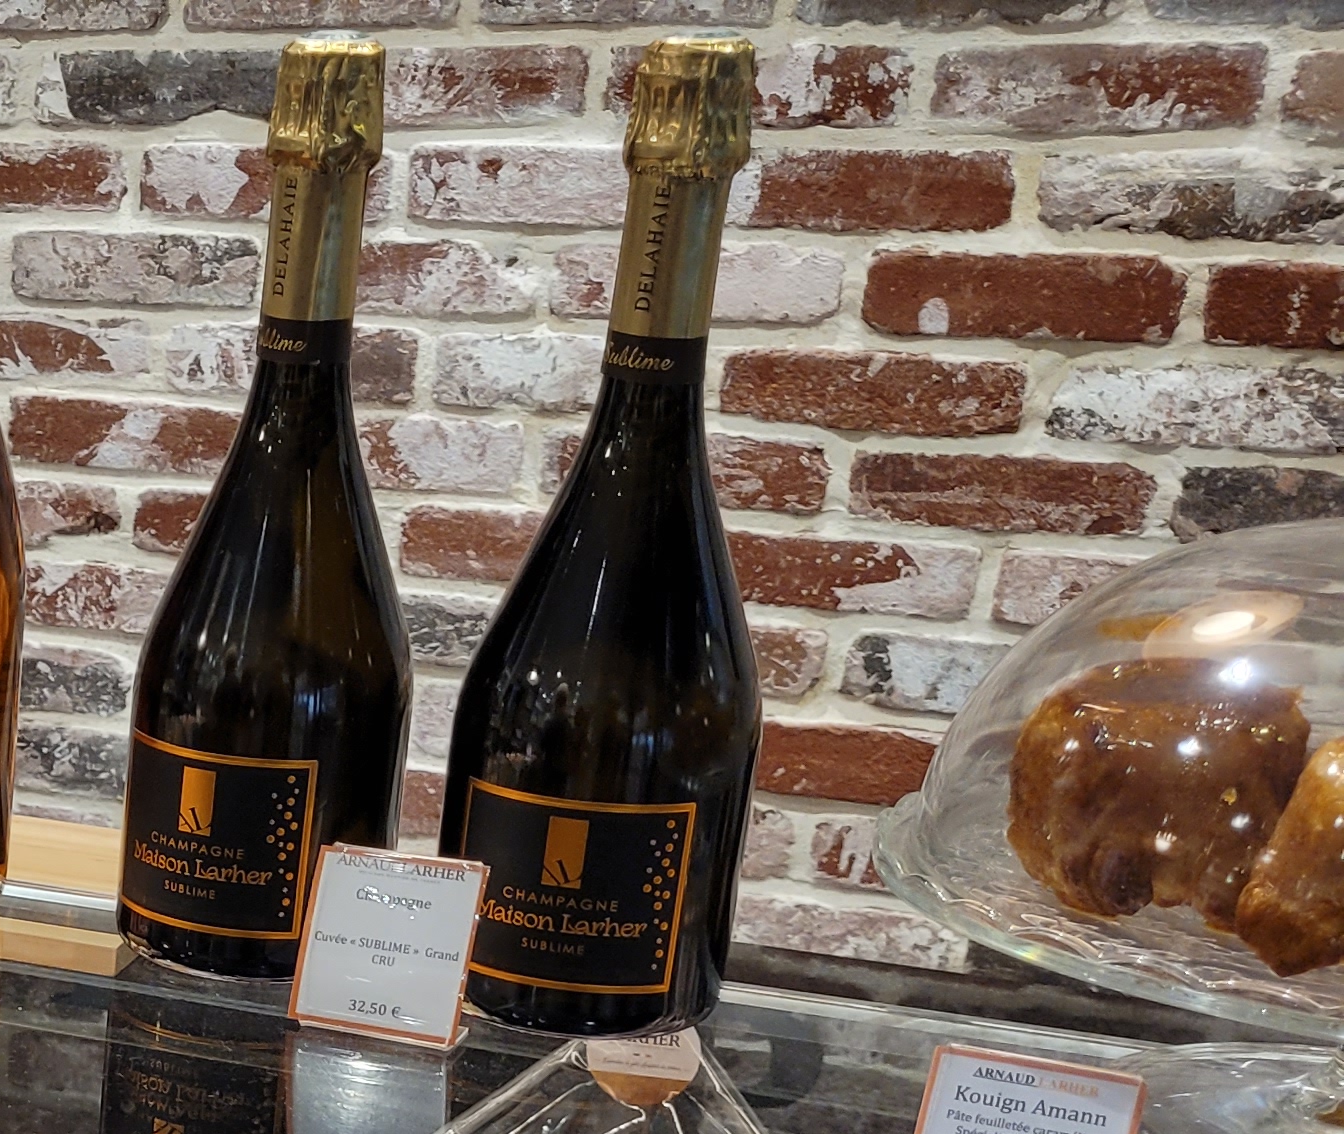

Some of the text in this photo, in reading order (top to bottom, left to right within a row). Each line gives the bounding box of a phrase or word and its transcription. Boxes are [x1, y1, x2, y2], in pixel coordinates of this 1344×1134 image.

[273, 177, 298, 298] DELAHAIE
[635, 185, 672, 312] DELAHAIE
[151, 831, 245, 860] CHAMPAGNE
[134, 839, 272, 885] Maison Larher
[164, 880, 216, 899] SUBLIME
[502, 885, 618, 912] CHAMPAGNE
[479, 900, 647, 938] Maison Larher
[315, 931, 459, 962] Cuvée SUBLIME Grand
[521, 937, 584, 955] SUBLIME
[372, 955, 395, 967] CRU
[348, 999, 402, 1018] 32,50 €
[973, 1067, 1036, 1086] ARNAUD
[955, 1085, 1107, 1127] Kouign Amann
[947, 1109, 972, 1122] Pâte
[975, 1114, 1030, 1133] feuilletée
